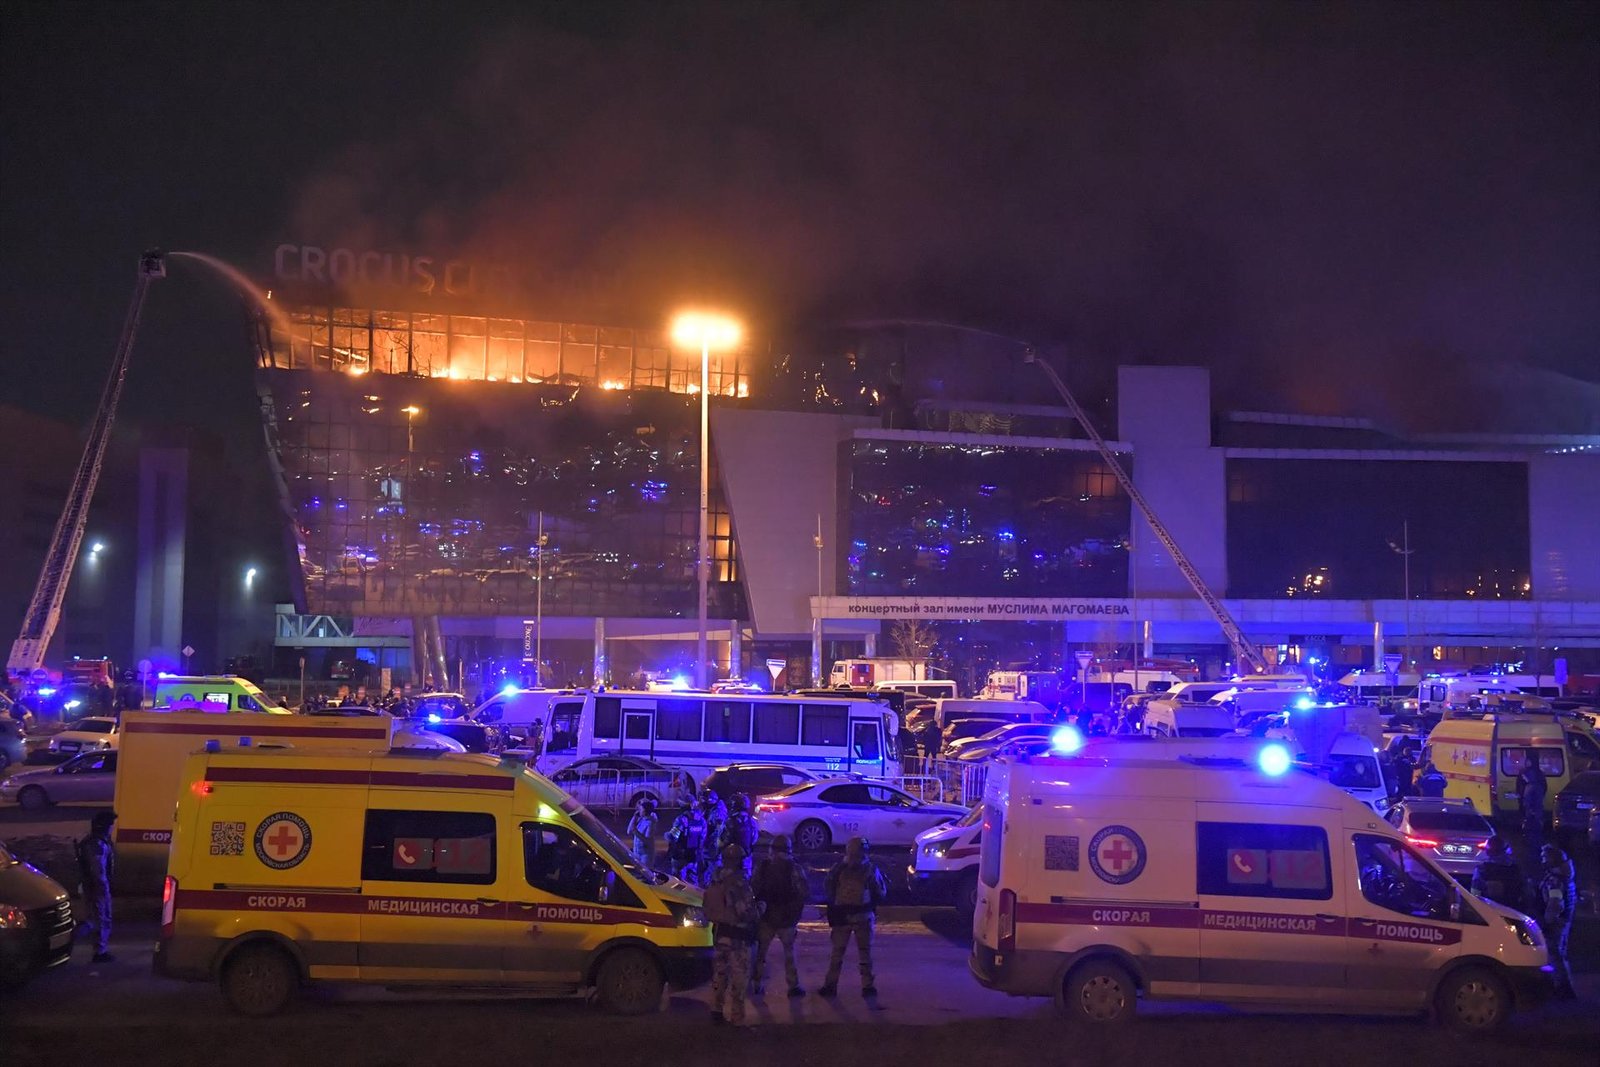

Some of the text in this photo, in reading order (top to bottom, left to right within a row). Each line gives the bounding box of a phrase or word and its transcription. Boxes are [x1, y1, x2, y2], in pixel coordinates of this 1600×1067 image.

[848, 603, 1130, 615] концертный зал имени МУСЛИМА МАГОМАЕВА
[524, 625, 533, 651] Экспо
[826, 763, 840, 771] 112
[257, 813, 310, 839] СКОРАЯ ПОМОЩЬ
[843, 822, 859, 832] 112
[248, 896, 603, 922] СКОРАЯ МЕДИЦИНСКАЯ ПОМОЩЬ
[1093, 910, 1443, 942] СКОРАЯ МЕДИЦИНСКАЯ ПОМОЩЬ
